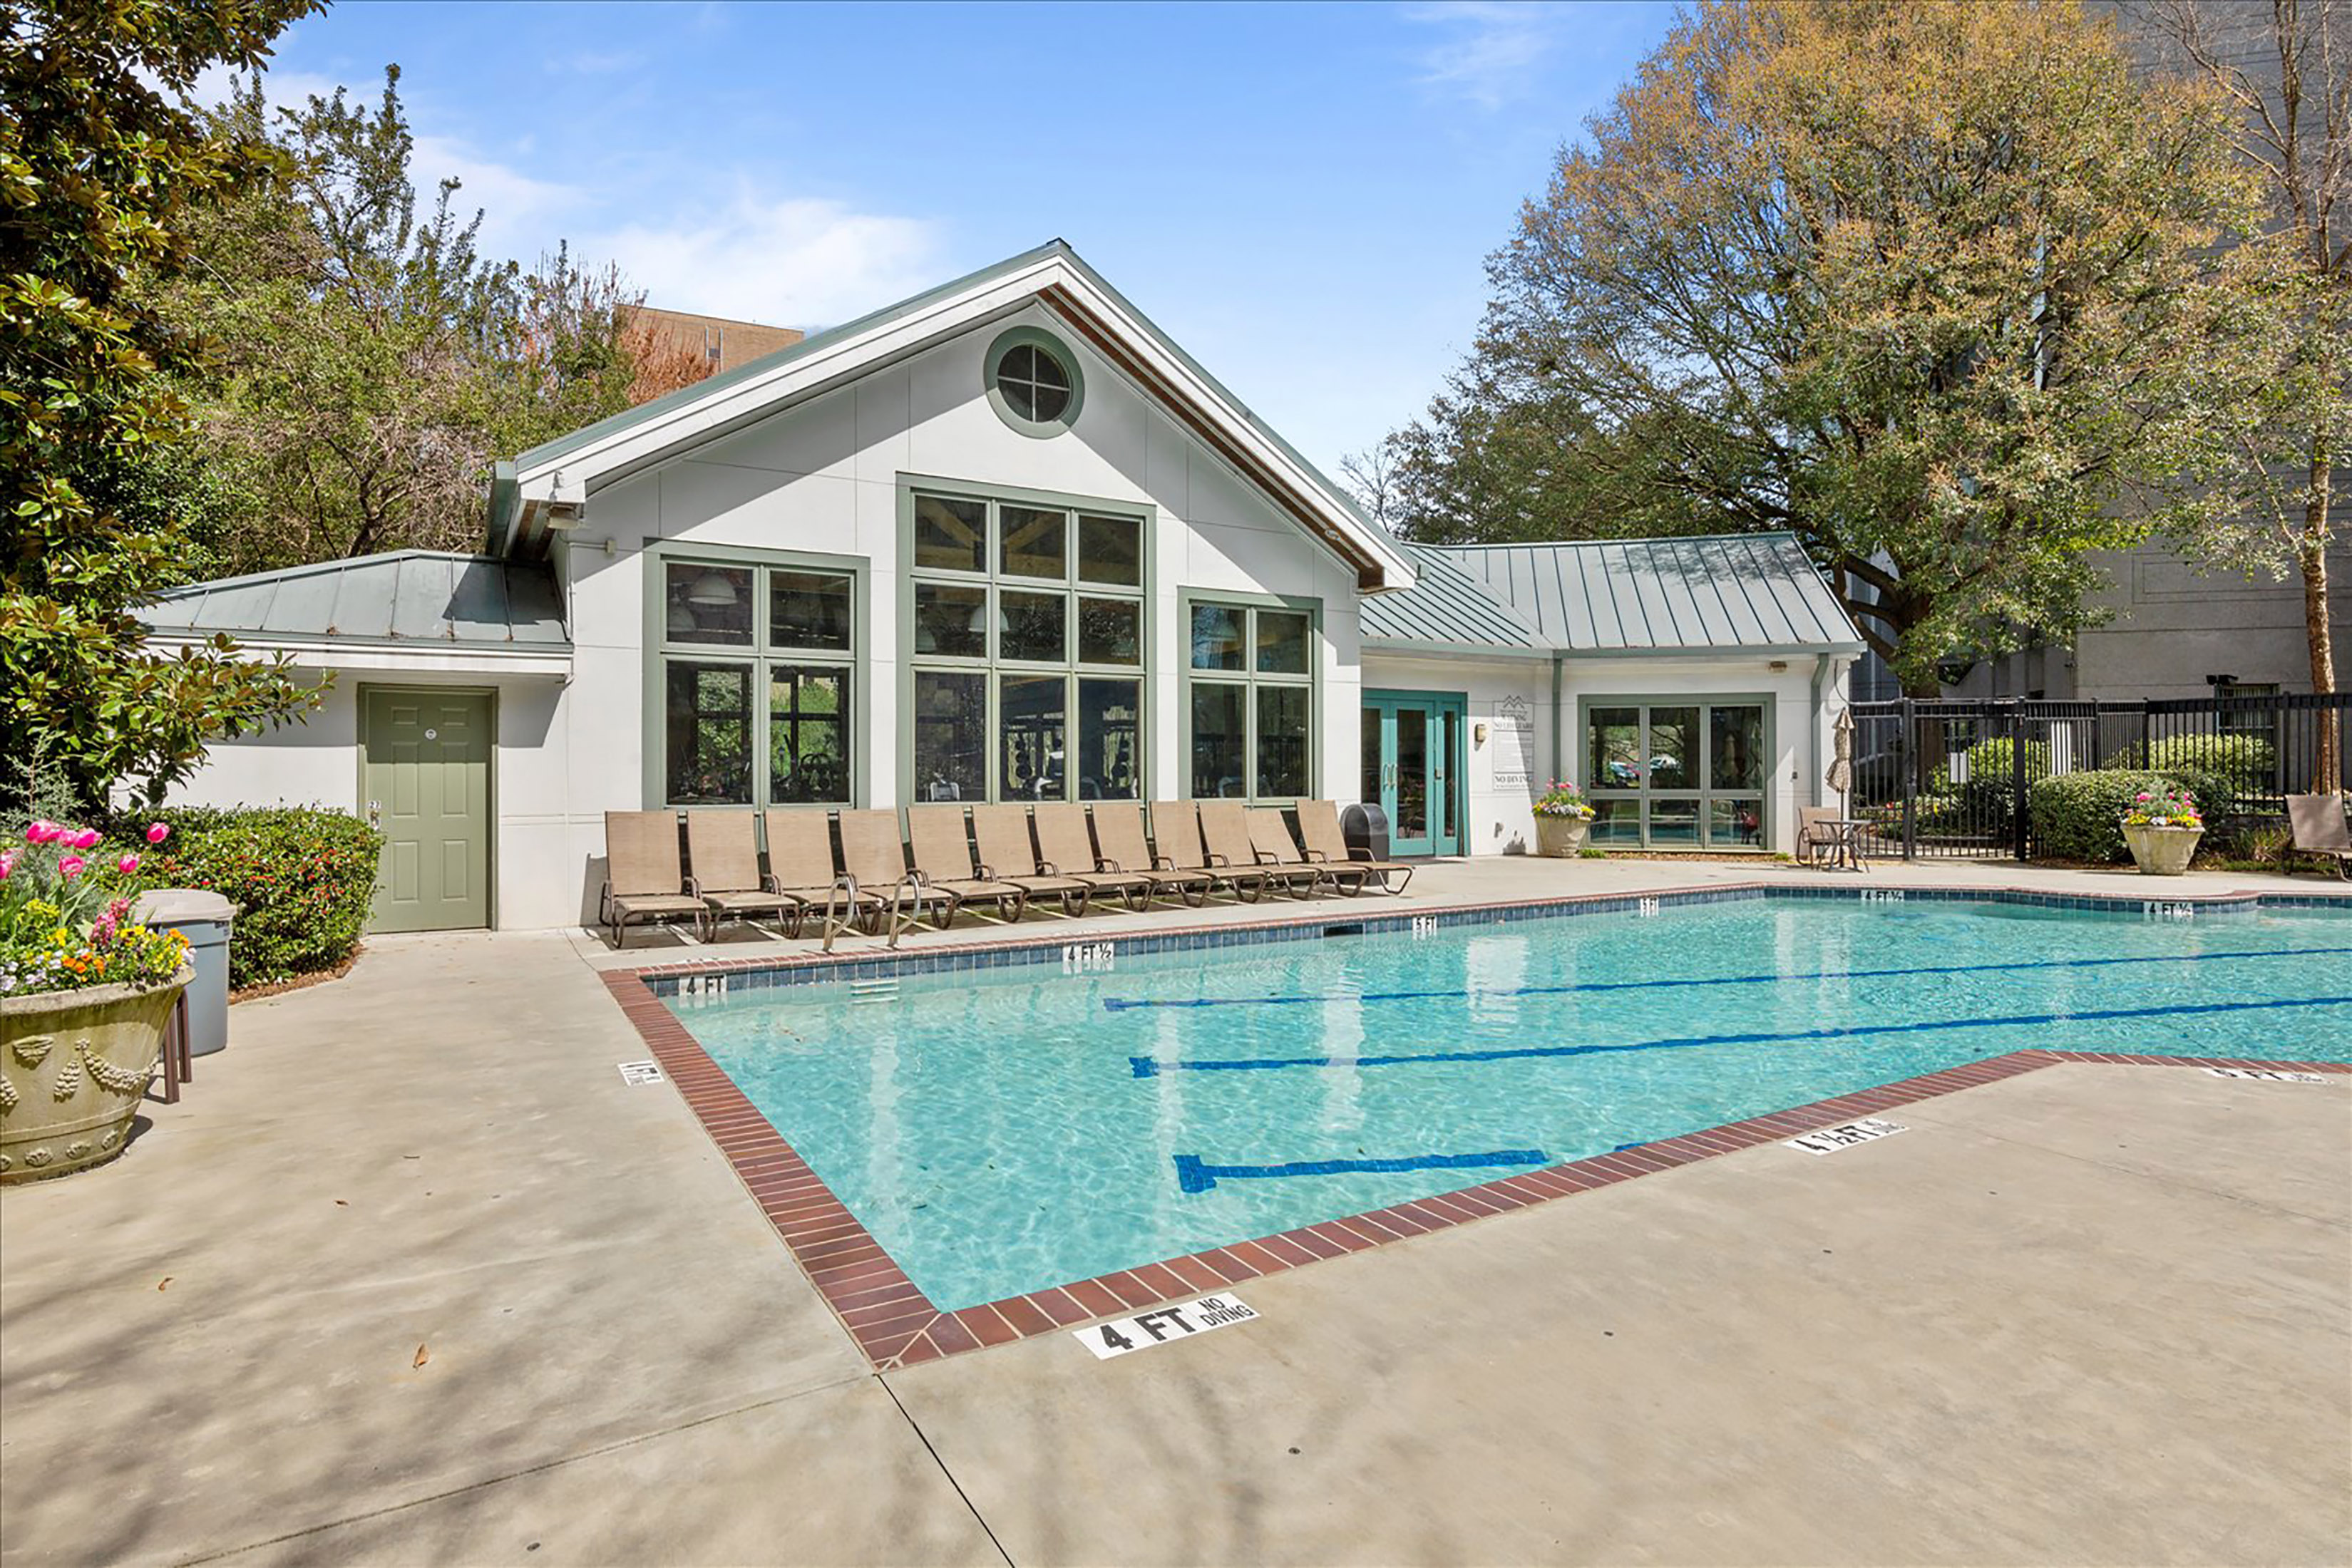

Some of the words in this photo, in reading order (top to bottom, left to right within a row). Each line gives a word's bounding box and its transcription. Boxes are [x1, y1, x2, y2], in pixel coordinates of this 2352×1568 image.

[1876, 891, 1889, 900] FT
[2149, 902, 2157, 914] 4
[2162, 902, 2176, 914] FT
[1416, 917, 1422, 930] 5
[1426, 916, 1436, 930] FT
[1068, 945, 1076, 961] 4
[1081, 944, 1097, 961] FT
[686, 976, 697, 995] 4
[704, 974, 724, 994] FT
[1833, 1125, 1880, 1141] FT
[1198, 1297, 1225, 1311] NO
[1200, 1304, 1255, 1326] DIVING
[1099, 1324, 1135, 1351] 4
[1132, 1306, 1197, 1342] FT
